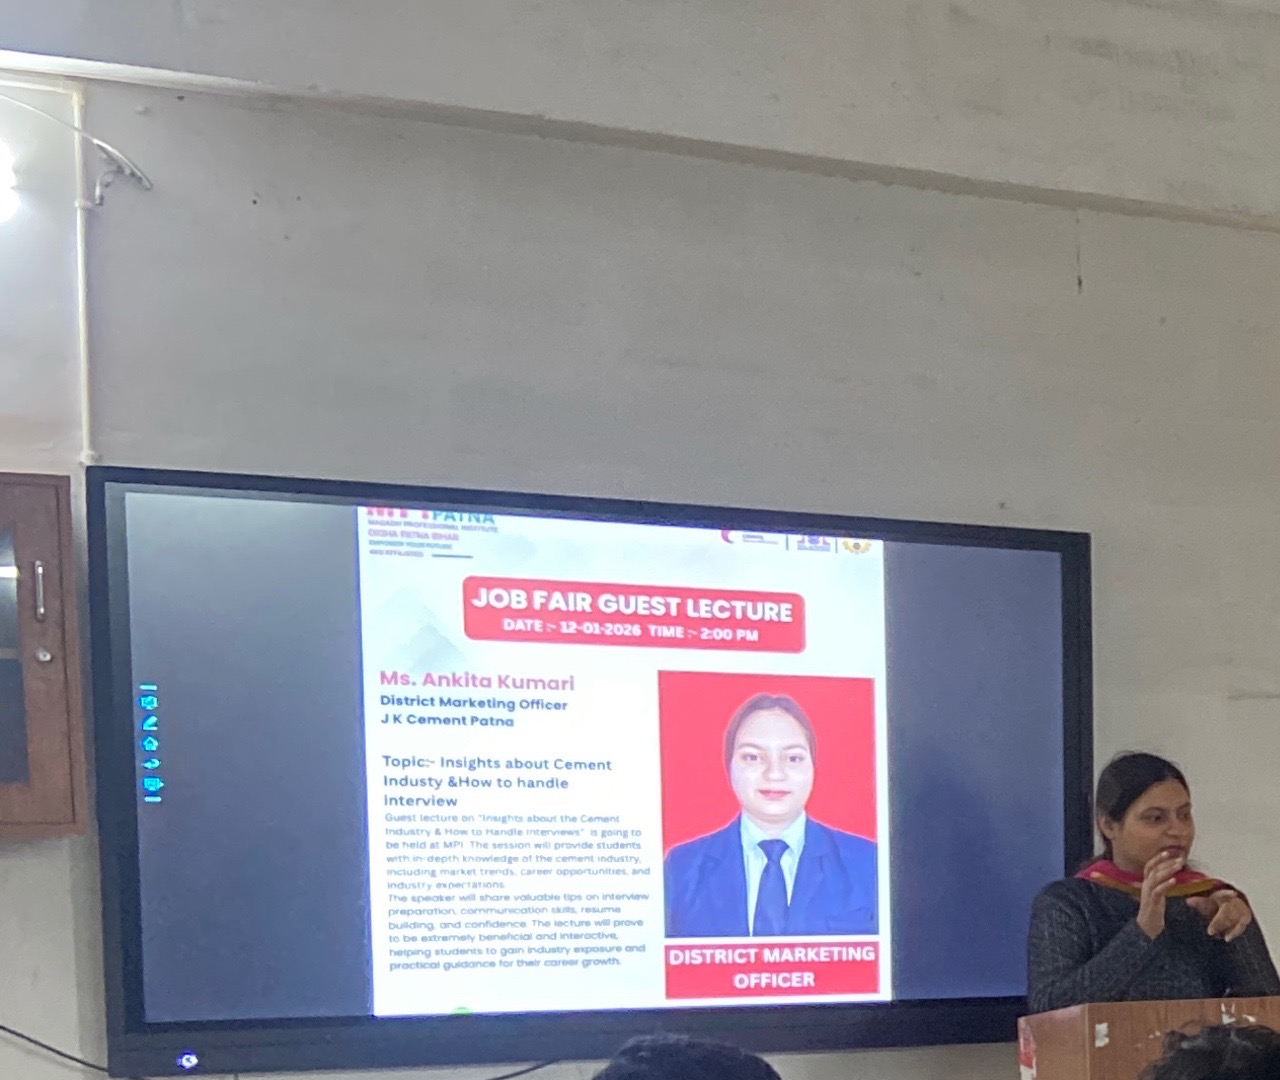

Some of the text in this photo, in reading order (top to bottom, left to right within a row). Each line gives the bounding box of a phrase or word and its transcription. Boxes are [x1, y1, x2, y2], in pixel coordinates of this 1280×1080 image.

[471, 587, 793, 622] JOB FAIR GUEST LECTURE
[503, 618, 543, 632] DATE
[560, 620, 642, 637] 12-01-2026
[648, 624, 684, 639] TIME
[700, 627, 733, 641] 2:00
[736, 628, 759, 642] PM
[380, 671, 575, 691] Ms. Ankita Kumari
[380, 694, 568, 712] District Marketing Officer
[381, 714, 514, 727] J K Cement Patna
[440, 757, 501, 771] Insights
[505, 757, 549, 770] about
[554, 758, 612, 771] Cement
[383, 775, 569, 790] Industy &How to handle
[384, 794, 458, 806] Interview
[385, 813, 416, 822] Guest
[420, 814, 458, 822] lecture
[527, 814, 557, 823] about
[560, 814, 578, 823] the
[580, 814, 620, 823] Cement
[385, 827, 431, 837] Industry
[445, 828, 468, 836] How
[472, 828, 482, 836] to
[590, 829, 598, 837] is
[601, 829, 628, 839] going
[631, 829, 642, 837] to
[385, 841, 400, 849] be
[402, 841, 427, 849] held
[429, 841, 440, 849] at
[470, 841, 489, 849] The
[534, 841, 551, 850] will
[554, 842, 594, 851] provide
[596, 842, 642, 850] students
[386, 855, 410, 863] with
[462, 855, 519, 865] knowledge
[522, 855, 533, 863] of
[535, 855, 553, 863] the
[555, 855, 595, 863] cement
[386, 868, 437, 878] including
[439, 868, 477, 877] market
[520, 868, 553, 877] career
[631, 867, 651, 876] and
[387, 881, 432, 891] industry
[389, 894, 408, 902] The
[411, 893, 456, 903] speaker
[459, 893, 476, 902] will
[480, 893, 511, 902] share
[513, 893, 561, 901] valuable
[563, 893, 582, 902] tips
[460, 906, 548, 915] communication
[581, 906, 621, 914] resume
[440, 921, 462, 929] and
[532, 919, 551, 928] The
[554, 919, 591, 928] lecture
[594, 918, 611, 927] will
[613, 919, 644, 928] prove
[389, 935, 400, 943] to
[403, 935, 418, 943] be
[421, 934, 476, 944] extremely
[478, 932, 533, 941] beneficial
[535, 932, 557, 941] and
[389, 944, 646, 959] helping students to gain industry exposure and
[669, 946, 876, 965] DISTRICT MARKETING
[389, 961, 440, 972] practical
[443, 960, 496, 971] guidance
[499, 959, 514, 968] for
[517, 958, 541, 967] their
[544, 959, 579, 967] career
[734, 972, 815, 989] OFFICER
